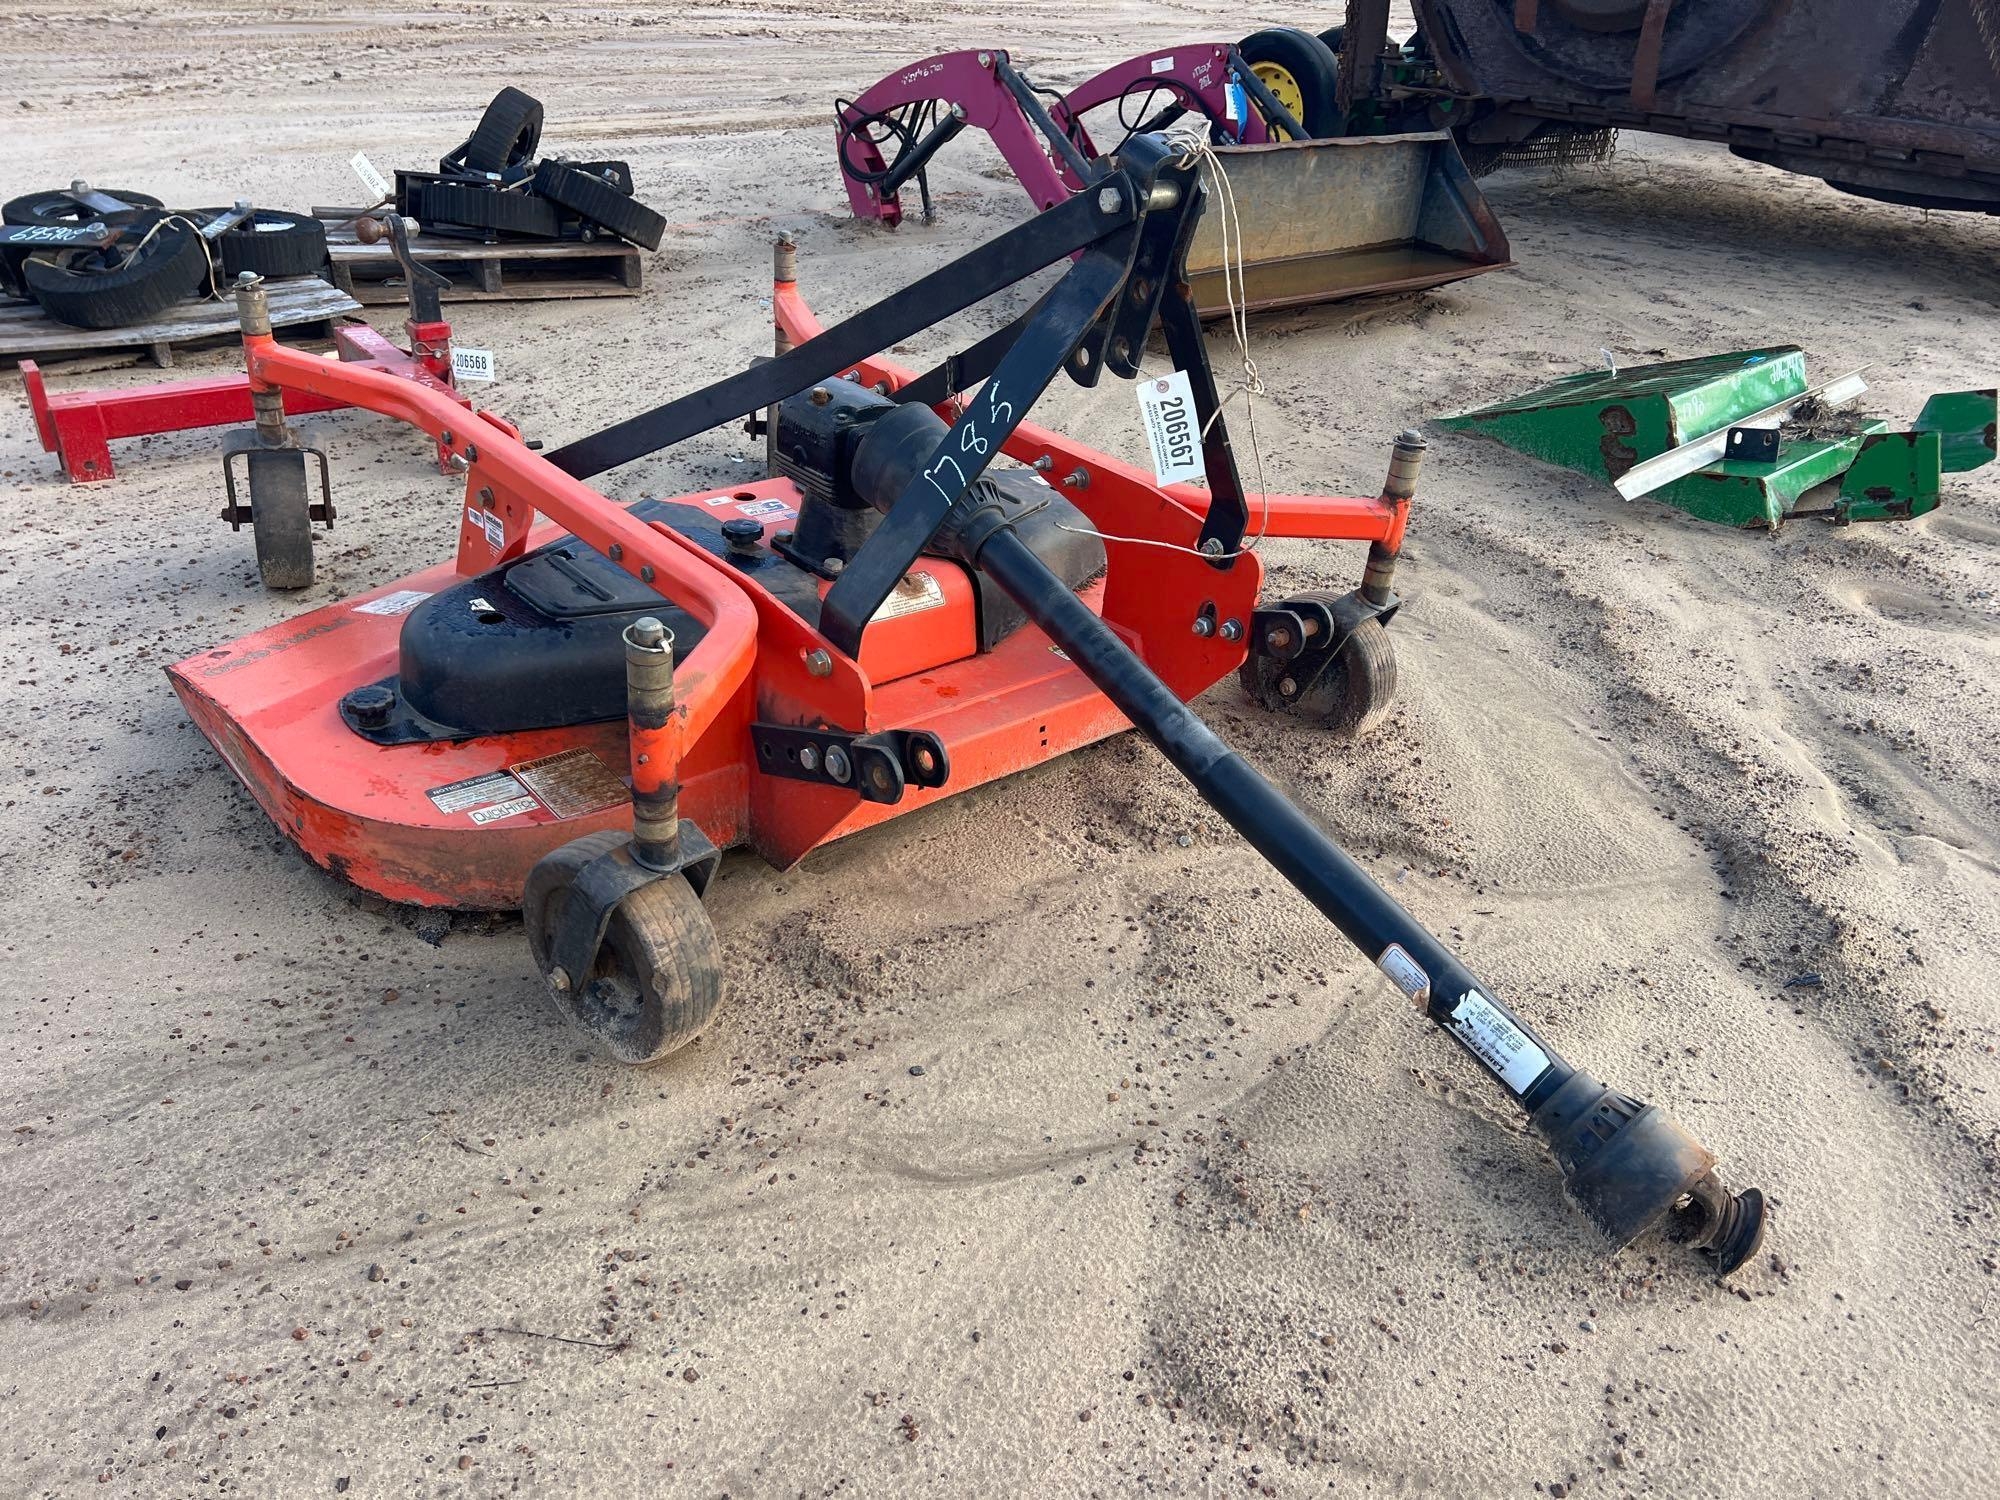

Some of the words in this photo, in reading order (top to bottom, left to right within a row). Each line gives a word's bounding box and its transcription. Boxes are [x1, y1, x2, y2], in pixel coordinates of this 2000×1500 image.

[456, 353, 487, 370] 206568
[1152, 403, 1160, 421] REBEL
[1156, 421, 1165, 446] AUCTION
[1161, 444, 1170, 470] COMPANY
[1160, 396, 1194, 467] 206567
[923, 380, 1012, 507] 1785
[530, 747, 589, 769] WARNING
[432, 782, 462, 795] NOTICE
[463, 780, 475, 788] TO
[1458, 1028, 1482, 1052] Pride
[1481, 1050, 1506, 1073] Land
